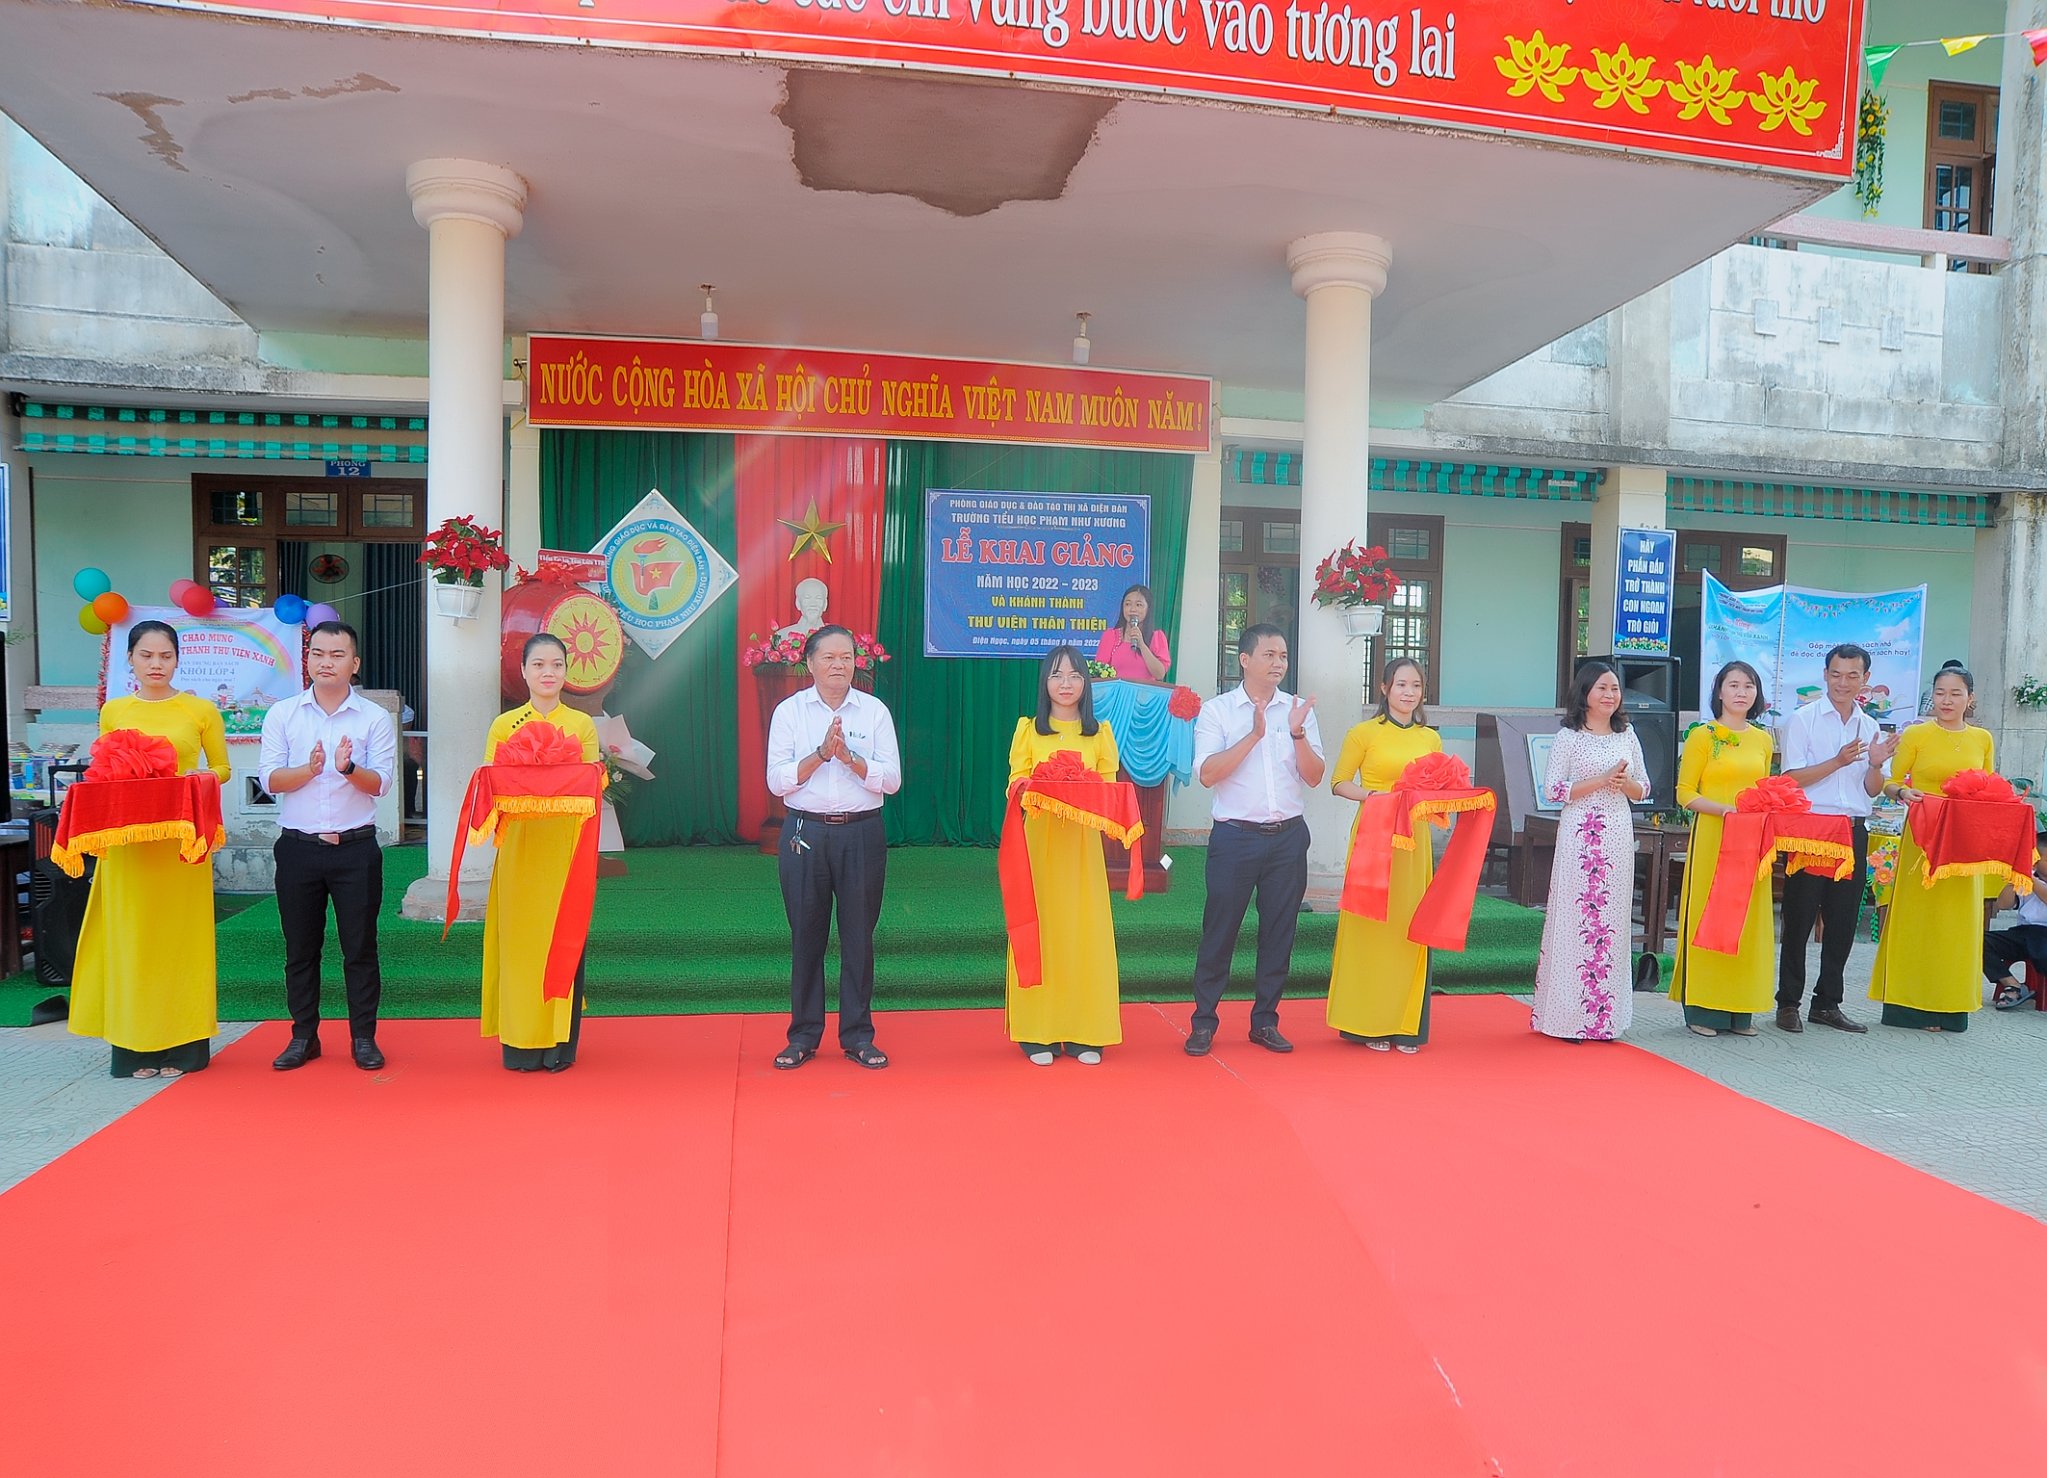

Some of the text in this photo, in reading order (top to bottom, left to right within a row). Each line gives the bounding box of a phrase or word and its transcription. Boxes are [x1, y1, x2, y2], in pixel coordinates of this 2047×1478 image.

[1286, 0, 1399, 87] tương
[1408, 8, 1456, 80] lai
[540, 350, 603, 405] NƯỚC
[612, 355, 675, 415] CỘNG
[683, 358, 730, 409] HÒA
[736, 363, 768, 411] XÃ
[776, 363, 815, 420] HỘI
[824, 363, 872, 416] CHỦ
[881, 373, 954, 419] NGHĨA
[963, 375, 1016, 428] VIỆT
[1025, 389, 1074, 425] NAM
[1080, 385, 1139, 428] MUÔN
[338, 467, 360, 476] 12
[950, 499, 977, 508] PHÒNG
[979, 500, 998, 509] GIÁO
[1000, 501, 1017, 511] DỤC
[1027, 502, 1044, 511] ĐÀO
[1046, 503, 1061, 513] TẠO
[1063, 504, 1076, 514] THỊ
[1078, 502, 1088, 512] XÃ
[1111, 504, 1128, 514] BÀN
[951, 512, 990, 524] TRƯỜNG
[992, 510, 1014, 525] TIỂU
[1017, 514, 1036, 528] HỌC
[1039, 515, 1068, 528] PHẠM
[1071, 517, 1092, 528] NHƯ
[941, 527, 1135, 568] LỄ KHAI GIẢNG
[1640, 539, 1656, 553] HÃY
[976, 573, 1003, 589] NĂM
[1006, 575, 1029, 592] HỌC
[1032, 577, 1059, 590] 2022
[1072, 578, 1099, 591] 2023
[1641, 579, 1665, 595] THÀNH
[991, 594, 1085, 609] VÀ KHÁNH THÀNH
[1623, 599, 1665, 614] CON NGOAN
[967, 614, 1107, 633] THƯ VIỆN THÂN THIỆN
[1627, 619, 1642, 633] TRÒ
[1030, 638, 1039, 646] 05
